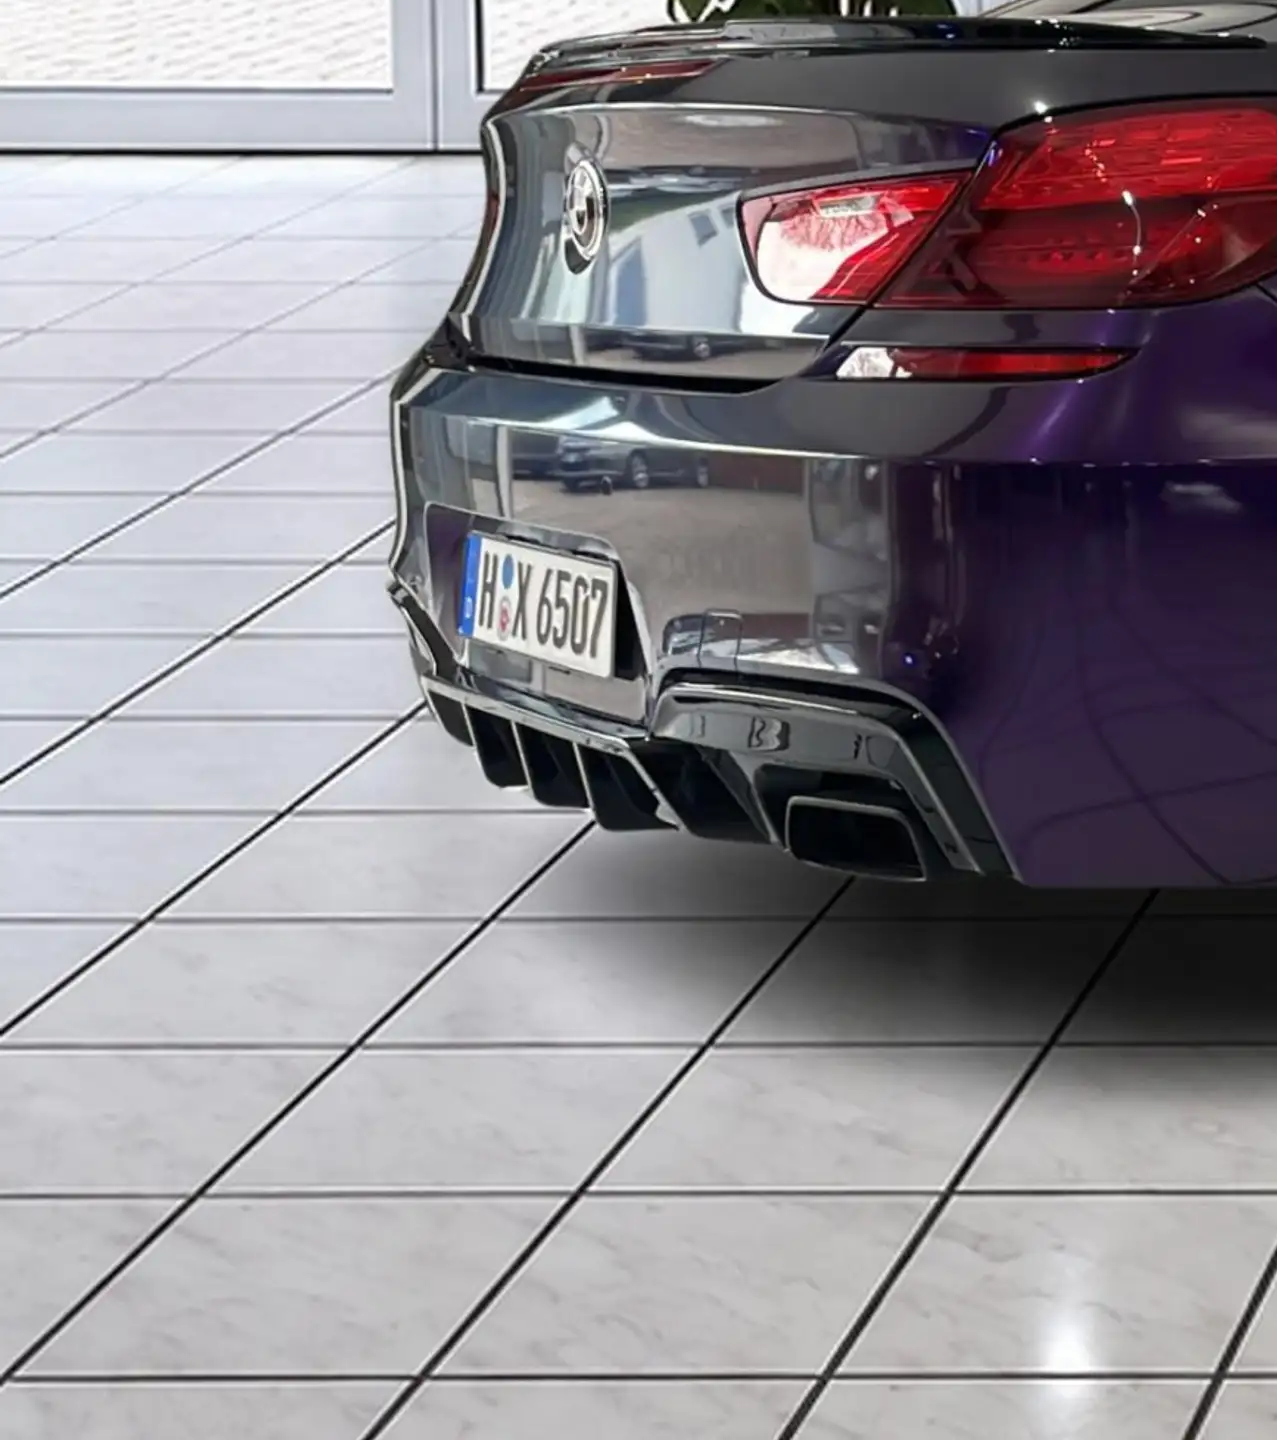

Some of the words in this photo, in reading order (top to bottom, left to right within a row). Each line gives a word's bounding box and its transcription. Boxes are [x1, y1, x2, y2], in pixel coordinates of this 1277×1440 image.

[478, 550, 499, 629] H
[511, 561, 533, 641] X
[536, 568, 609, 659] 6507
